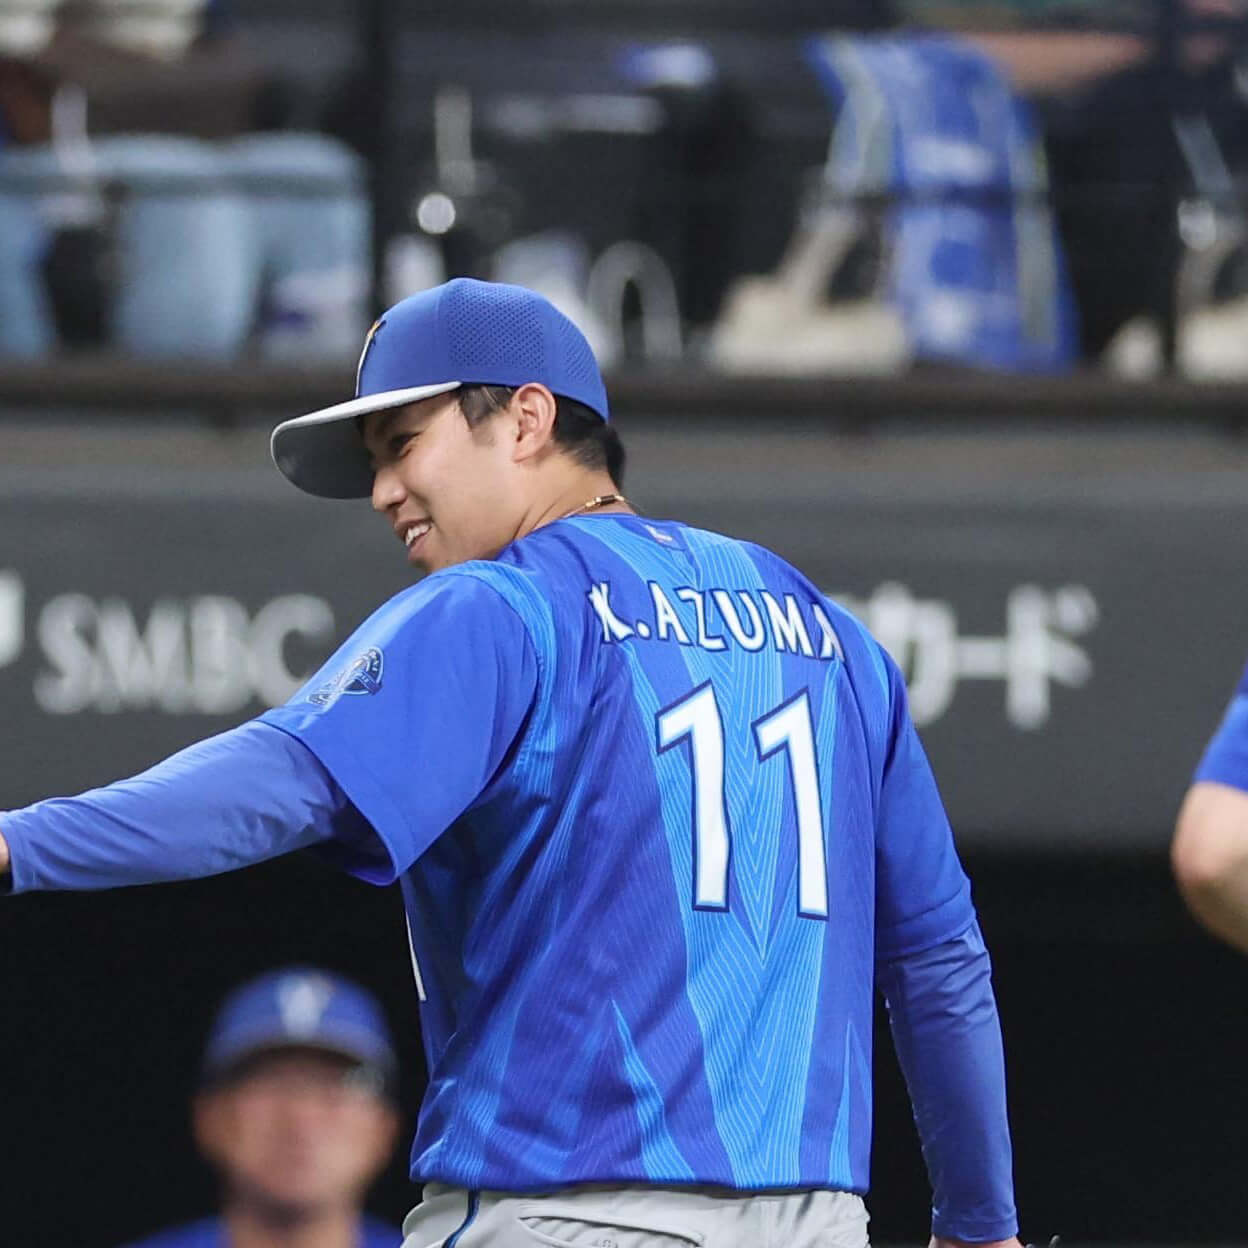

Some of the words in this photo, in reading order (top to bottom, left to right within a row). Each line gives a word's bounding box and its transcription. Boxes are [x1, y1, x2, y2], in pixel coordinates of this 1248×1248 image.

[33, 592, 336, 715] SMBC
[587, 580, 846, 663] K.AZUMA
[656, 680, 829, 919] 11
